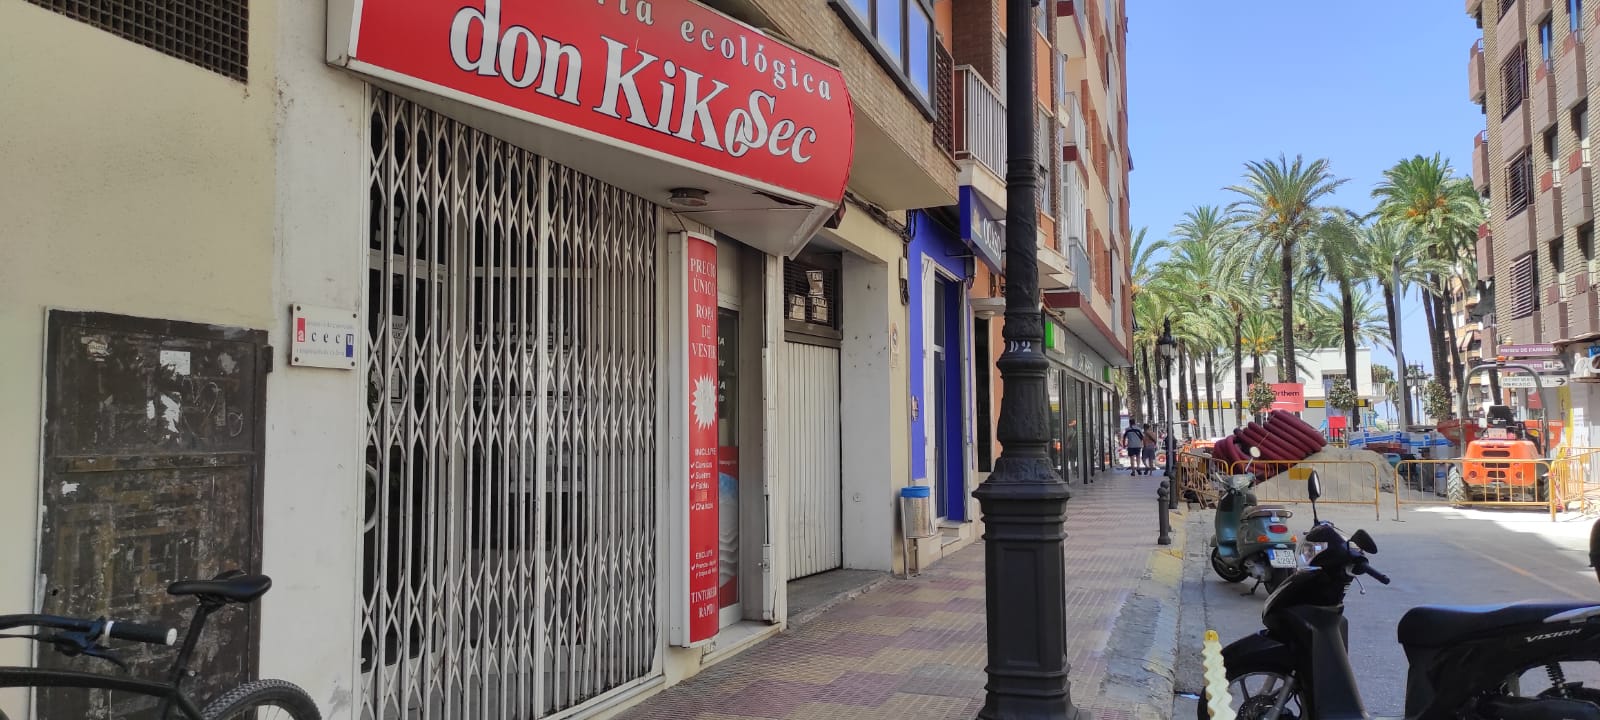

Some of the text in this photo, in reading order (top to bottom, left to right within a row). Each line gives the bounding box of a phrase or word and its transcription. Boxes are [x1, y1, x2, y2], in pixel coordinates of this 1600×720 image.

[449, 0, 583, 106] don
[679, 18, 833, 102] ecológica
[690, 257, 716, 278] PRECIO
[693, 274, 716, 297] ÚNICO
[695, 303, 714, 321] ROPA
[701, 324, 712, 340] DE
[1524, 628, 1582, 643] VISION
